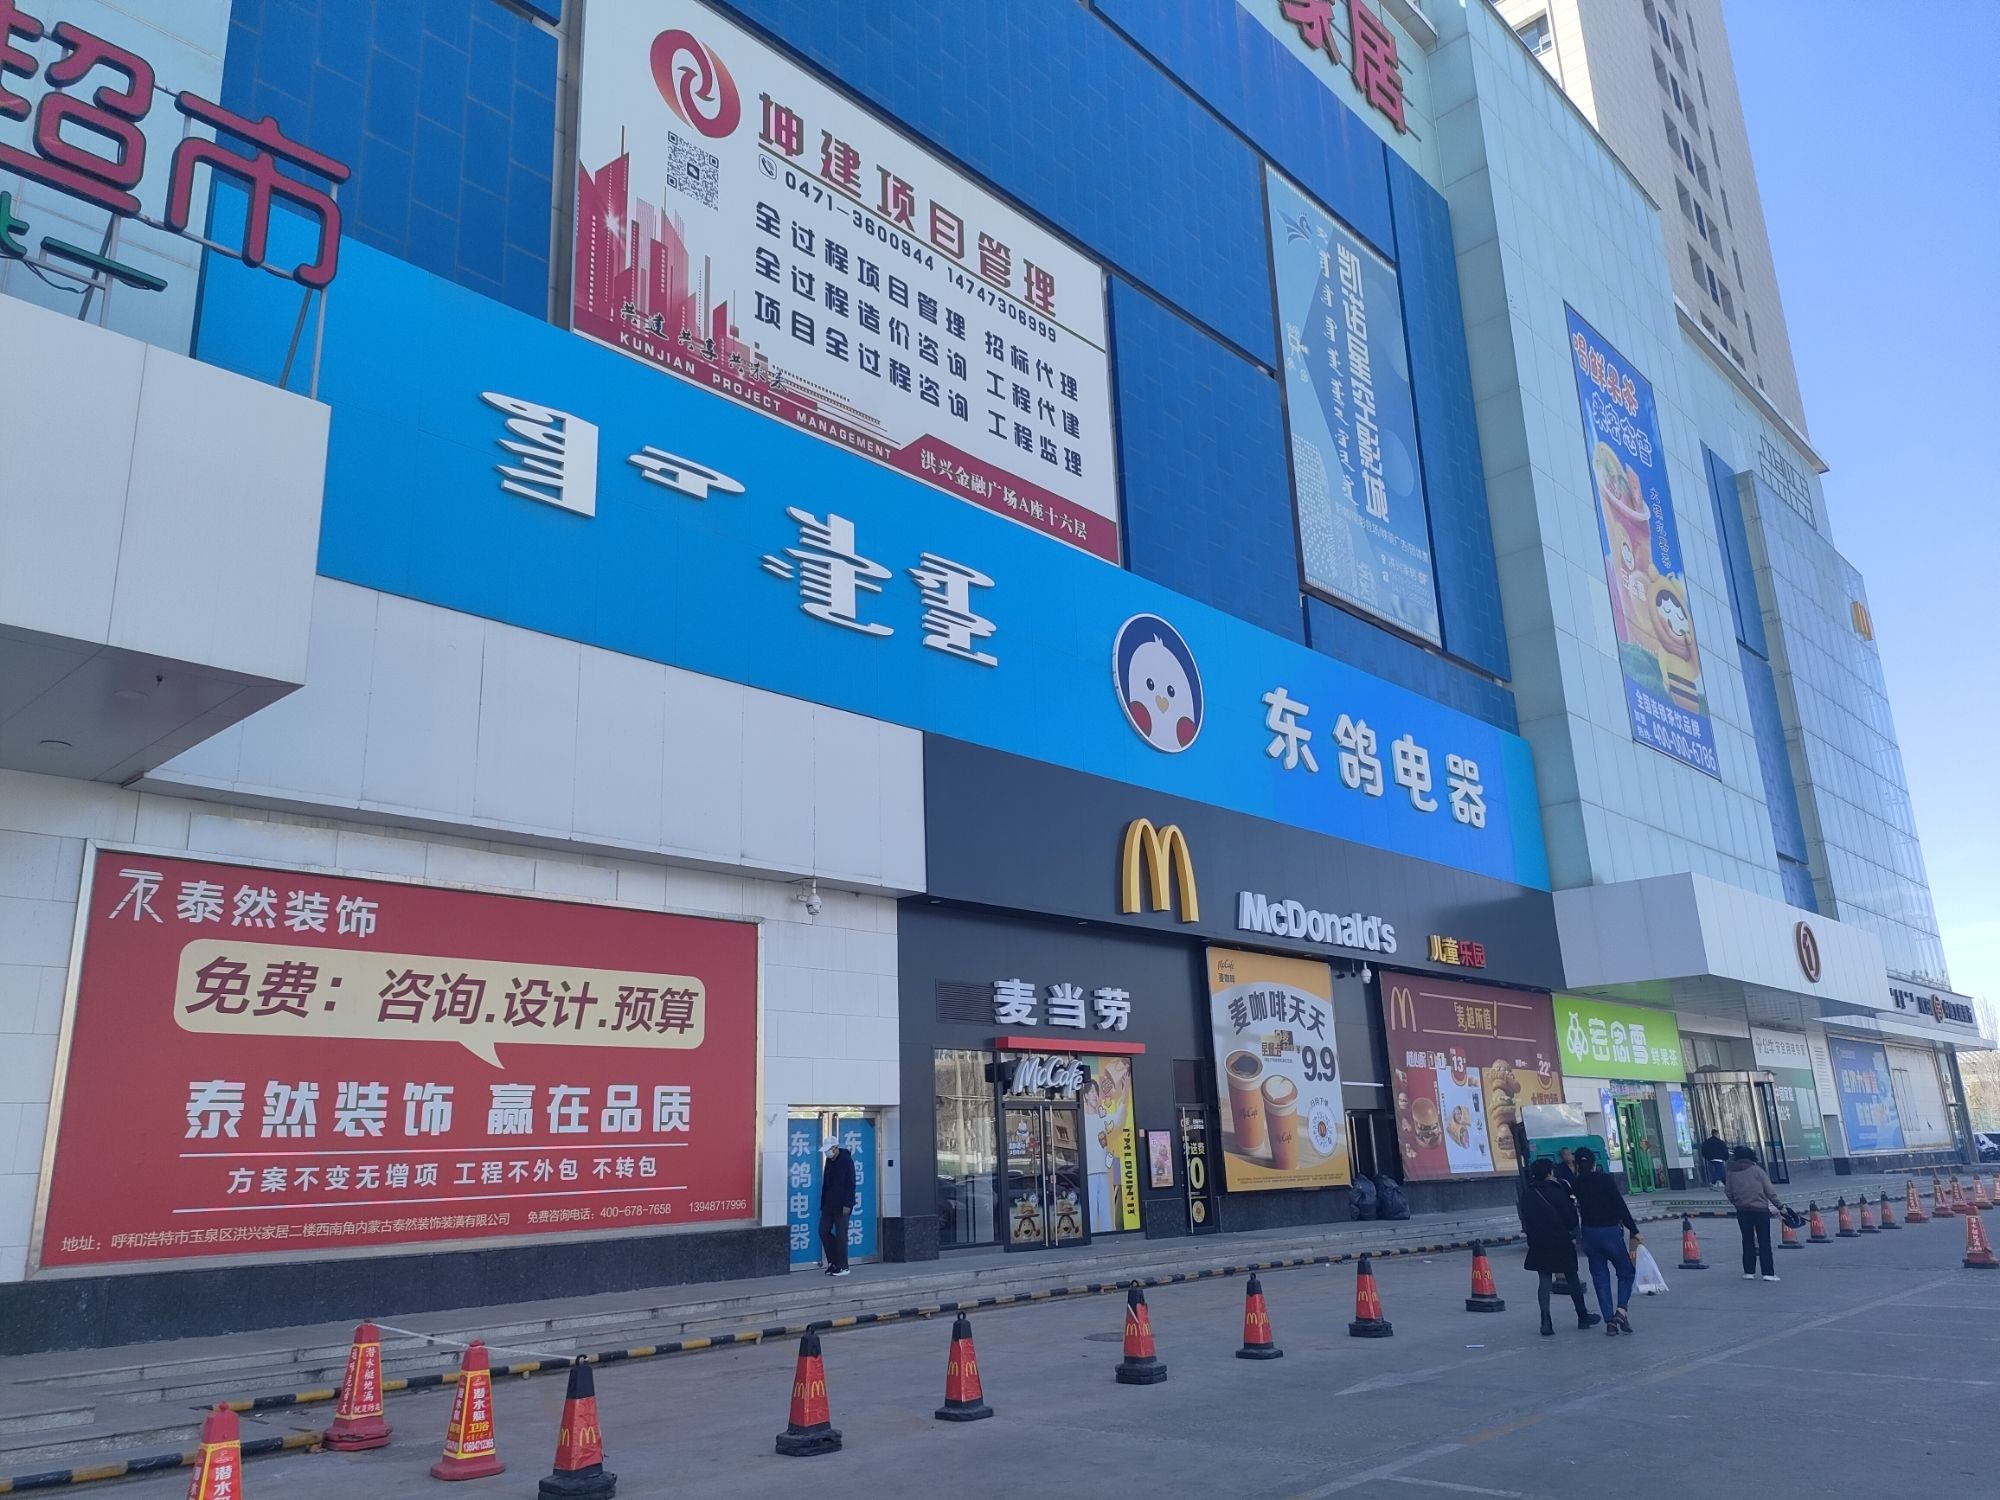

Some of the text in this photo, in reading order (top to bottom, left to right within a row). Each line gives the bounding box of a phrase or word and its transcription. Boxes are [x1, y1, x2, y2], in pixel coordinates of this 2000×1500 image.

[758, 91, 1056, 318] 坤建项目管理
[785, 170, 1057, 343] 0471-3600944 14747306999
[755, 201, 1078, 402] 全过程项目管理 招标代理
[755, 246, 1081, 440] 全过程造价咨询 工程代建
[620, 331, 892, 460] KUNJIAN PROJECT MANAGEMENT
[754, 290, 1083, 478] 项目全过程咨询 工程监理
[920, 448, 1088, 541] 洪兴金融广场A座十六层
[1263, 688, 1488, 829] 东鸽电器
[176, 879, 380, 939] 泰然装饰
[1238, 890, 1397, 955] McDonald's
[1428, 934, 1487, 968] 儿童乐园
[993, 977, 1131, 1031] 麦当劳
[1228, 990, 1326, 1041] 麦咖啡天天
[183, 1079, 693, 1139] 泰然装饰 赢在品质
[226, 1155, 658, 1195] 方案不变无增项 工程不外包 不转包
[790, 1131, 812, 1250] 东鸽电器
[688, 1199, 747, 1214] 13948717996
[362, 1346, 377, 1403] 潜水艇地漏
[472, 1387, 486, 1422] 潜水艇
[468, 1421, 490, 1434] 卫浴
[213, 1465, 233, 1500] 潜水
